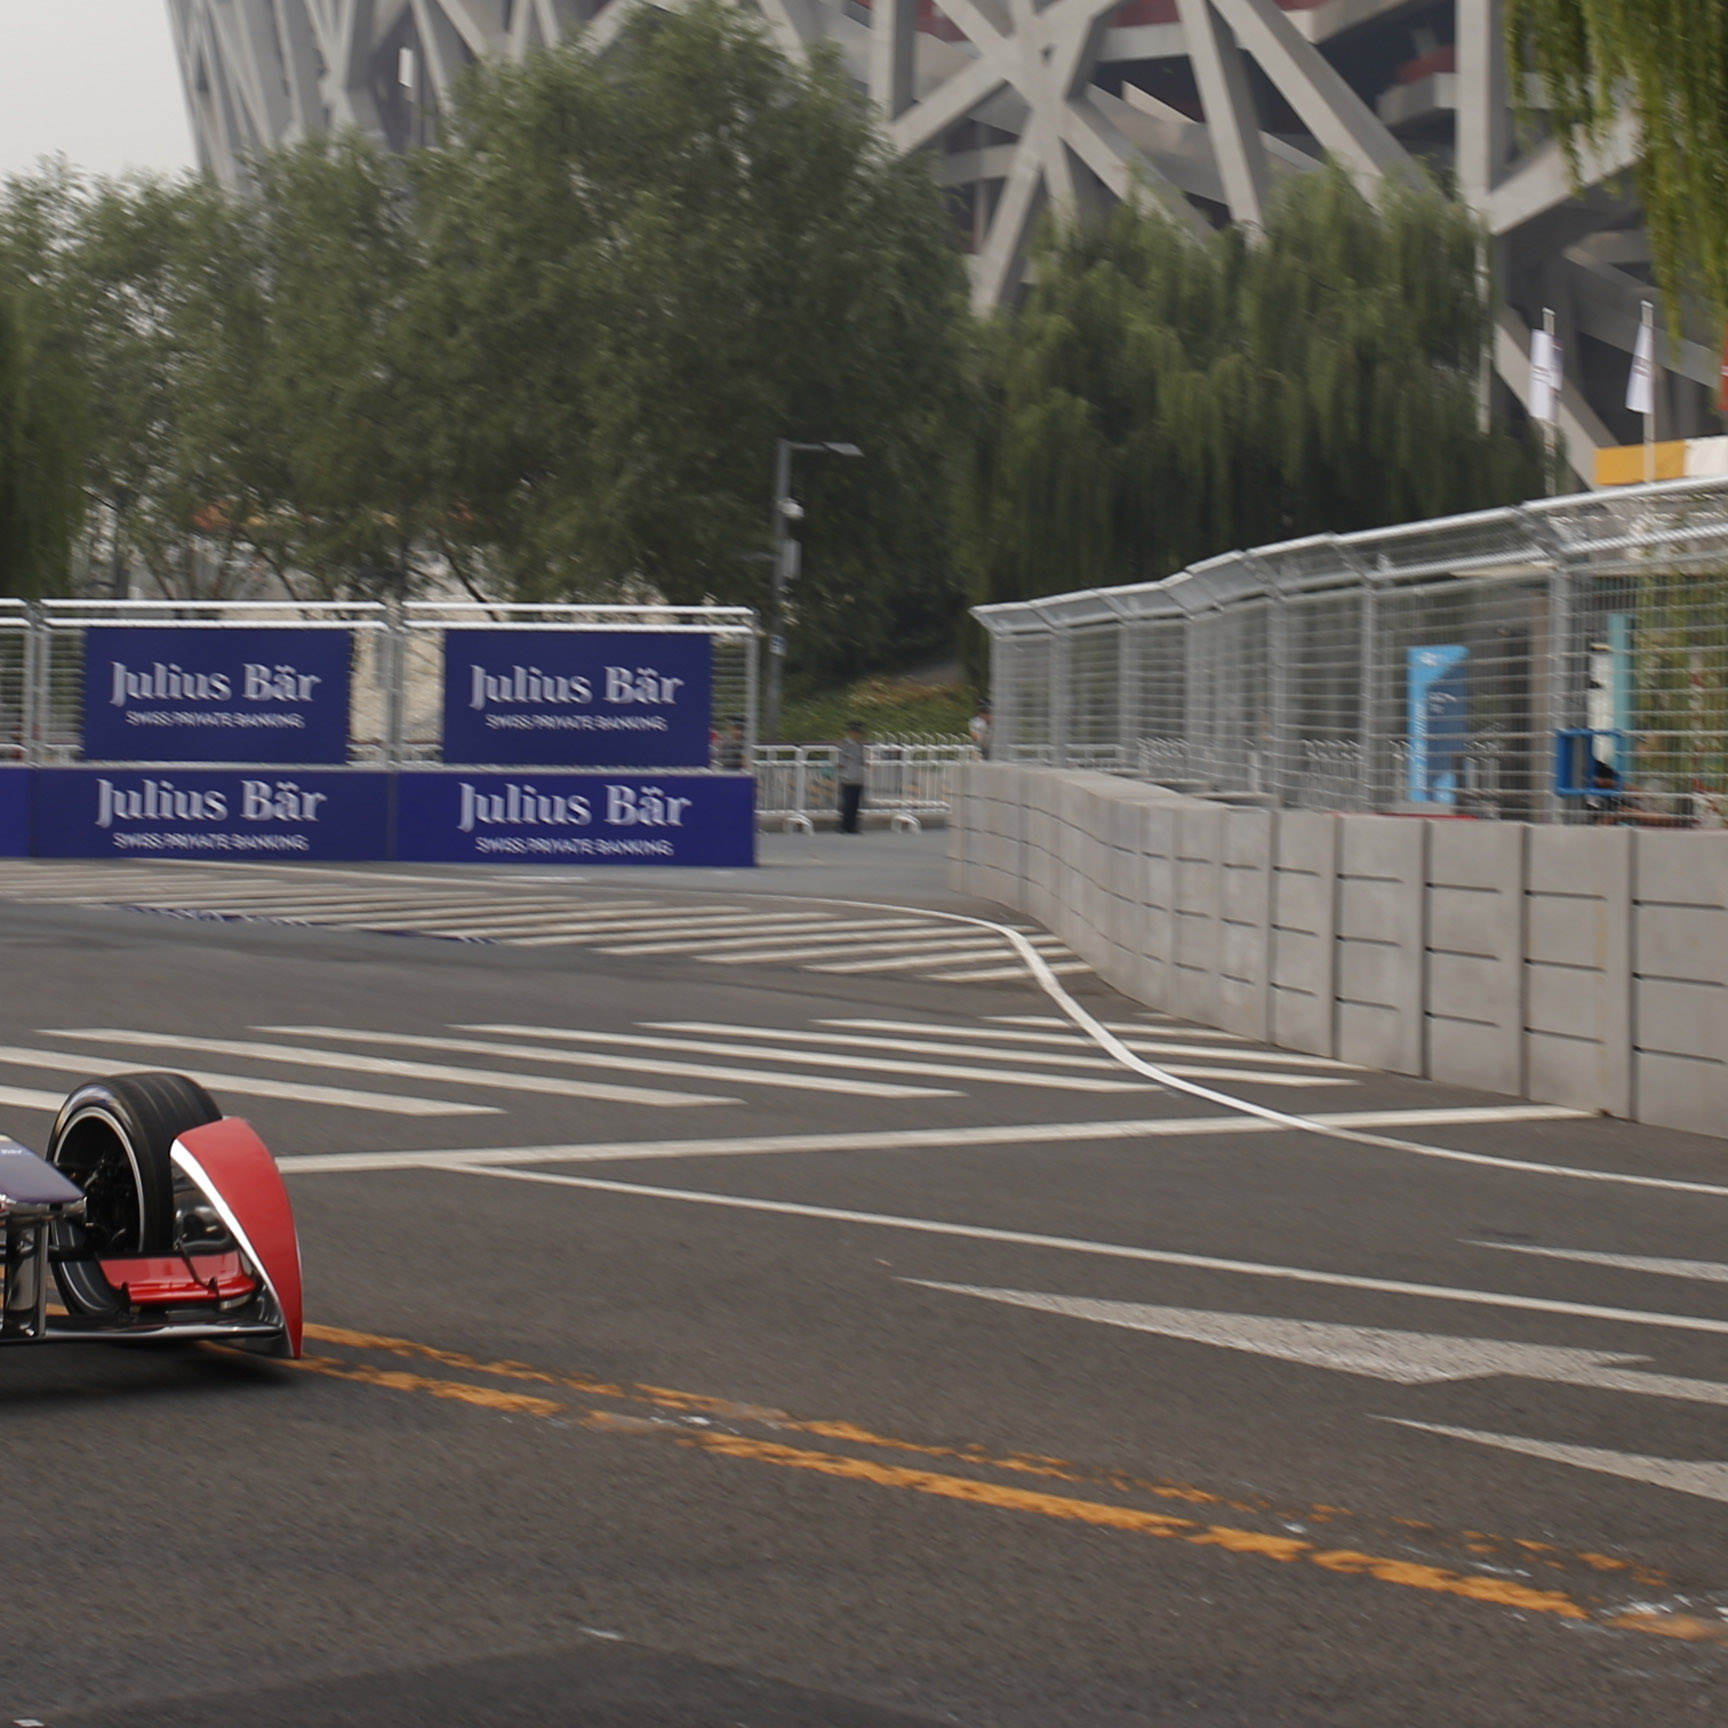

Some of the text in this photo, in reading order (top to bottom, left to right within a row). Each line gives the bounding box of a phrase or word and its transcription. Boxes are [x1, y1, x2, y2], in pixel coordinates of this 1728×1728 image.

[110, 662, 322, 706] Julius Bär
[469, 665, 684, 709] Julius Bär
[95, 779, 327, 827] Julius Bär
[457, 783, 692, 832] Julius Bär
